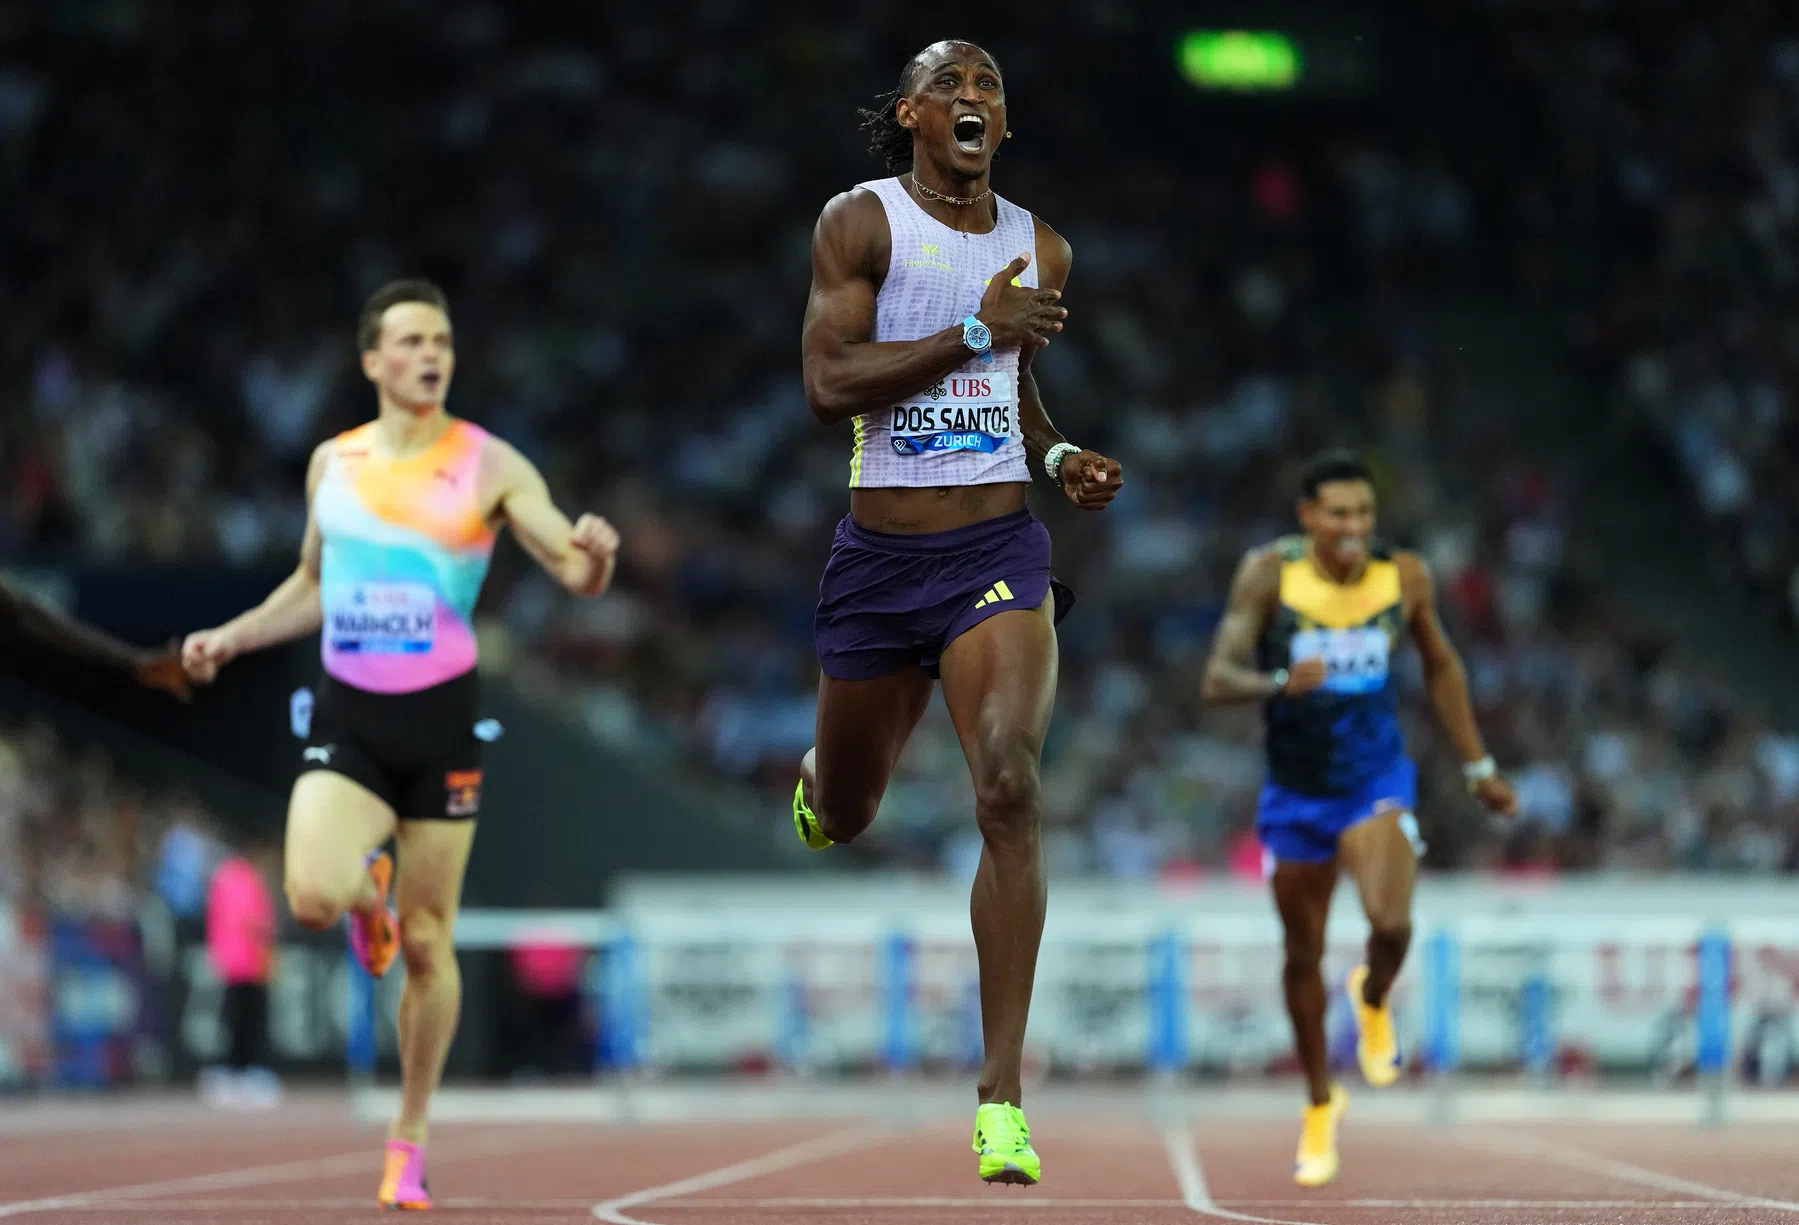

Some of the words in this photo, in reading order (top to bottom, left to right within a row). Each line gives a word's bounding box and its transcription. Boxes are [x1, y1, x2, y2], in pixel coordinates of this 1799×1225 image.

[951, 378, 991, 397] UBS
[893, 406, 935, 432] DOS
[940, 406, 1010, 433] SANTOS
[934, 434, 982, 448] ZURICH
